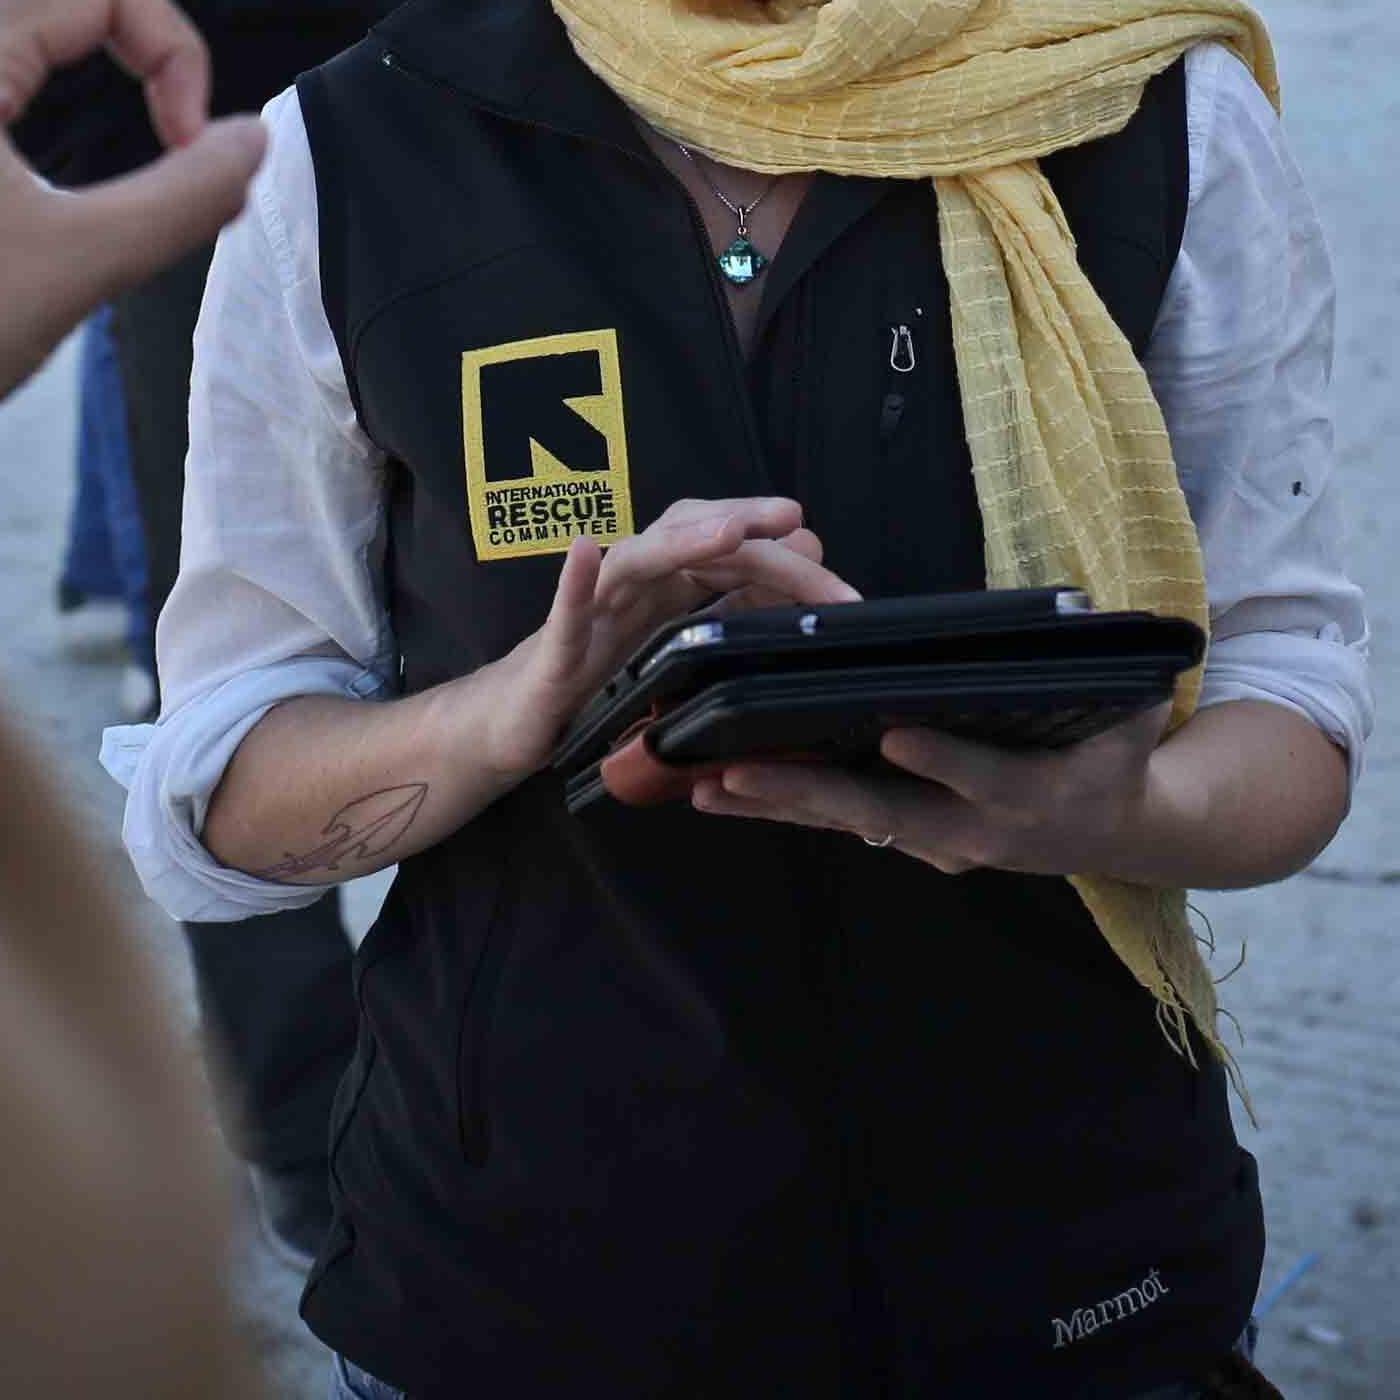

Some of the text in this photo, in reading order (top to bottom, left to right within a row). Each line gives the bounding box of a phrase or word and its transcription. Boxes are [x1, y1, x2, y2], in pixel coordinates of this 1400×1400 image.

[486, 482, 612, 504] INTERNATIONAL
[488, 494, 616, 528] RESCUE
[489, 519, 616, 545] COMMITTEE
[1052, 1267, 1169, 1348] Marmot
